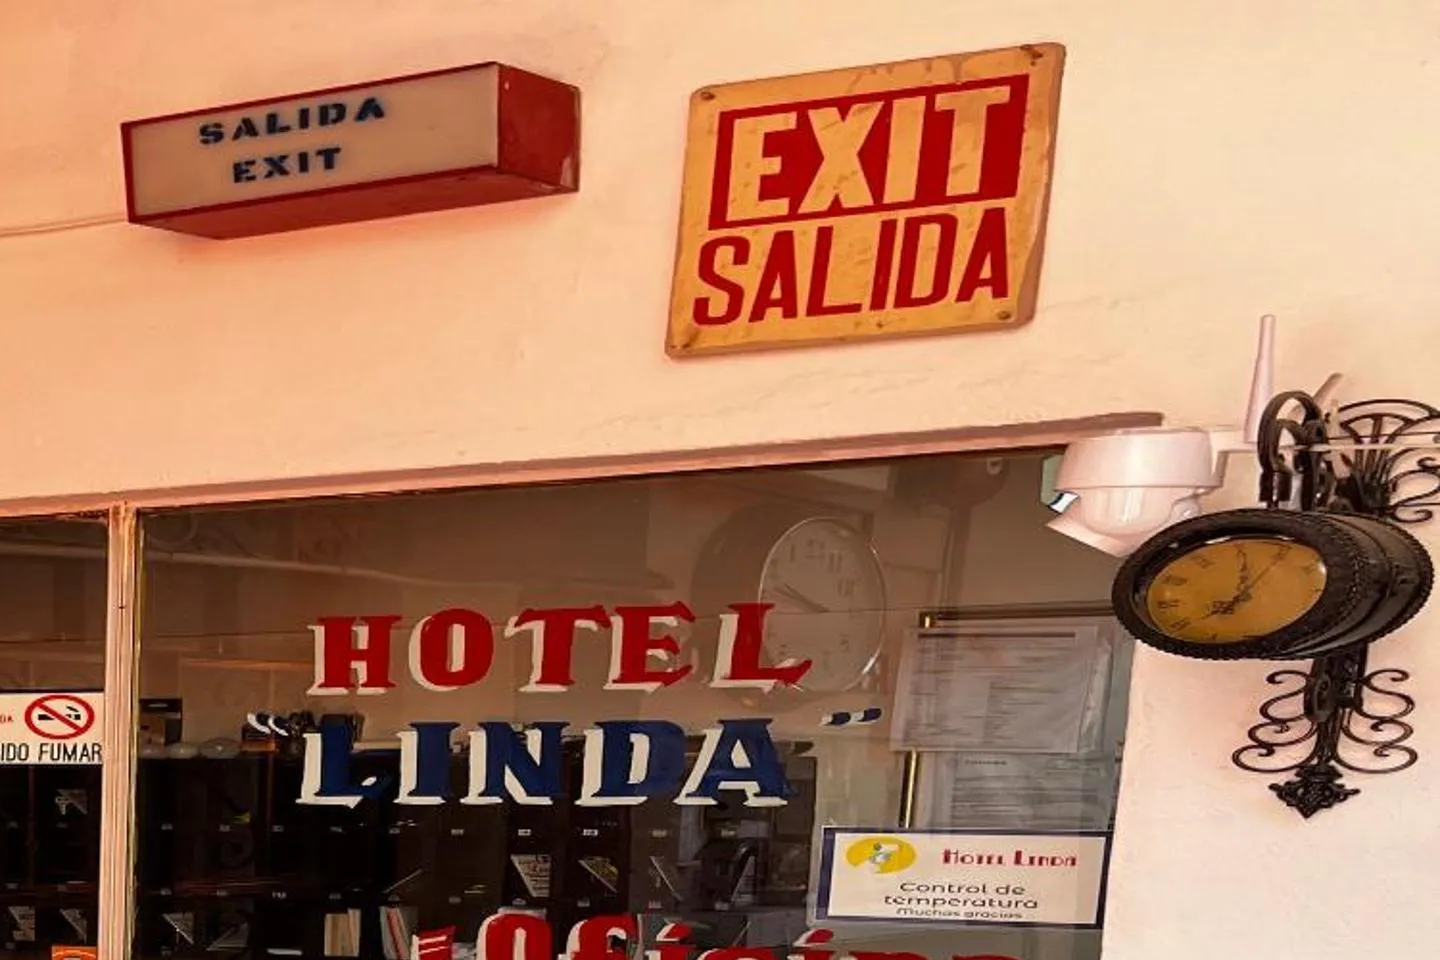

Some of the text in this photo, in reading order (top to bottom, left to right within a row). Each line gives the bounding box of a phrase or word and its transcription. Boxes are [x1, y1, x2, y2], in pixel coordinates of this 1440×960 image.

[199, 97, 385, 145] SALIDA
[232, 147, 342, 183] EXIT
[725, 85, 1010, 224] EXIT
[692, 206, 1010, 328] SALIDA
[306, 601, 812, 698] HOTEL
[38, 742, 103, 762] FUMAR
[884, 895, 1040, 911] temperatura
[899, 881, 1026, 896] Control de
